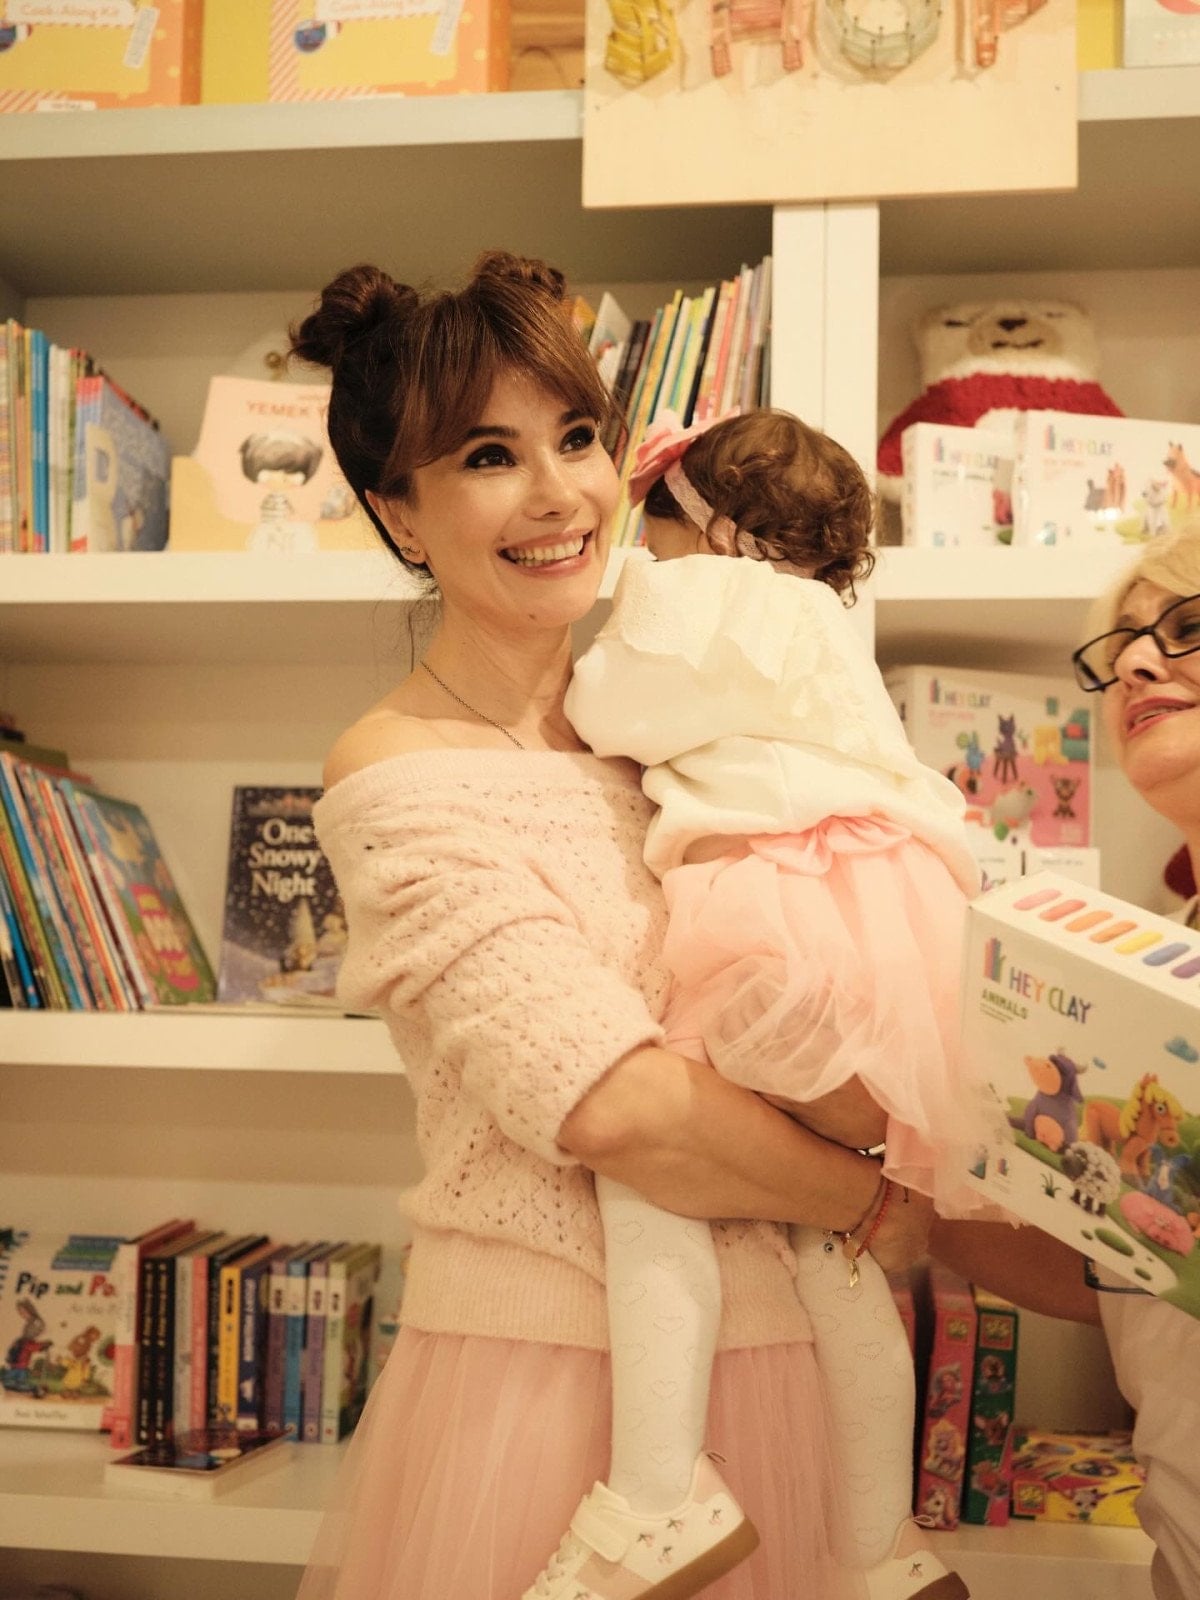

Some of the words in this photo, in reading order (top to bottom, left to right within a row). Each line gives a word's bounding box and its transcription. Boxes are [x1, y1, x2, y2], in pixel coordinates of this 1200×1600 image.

[262, 817, 313, 845] One
[247, 841, 321, 875] Snowy
[252, 869, 316, 903] Night
[981, 988, 1029, 1020] ANIMALS
[1009, 966, 1046, 1003] HEY
[1048, 987, 1092, 1024] CLAY
[15, 1272, 49, 1299] Pip
[55, 1281, 83, 1296] and
[88, 1273, 118, 1298] Po
